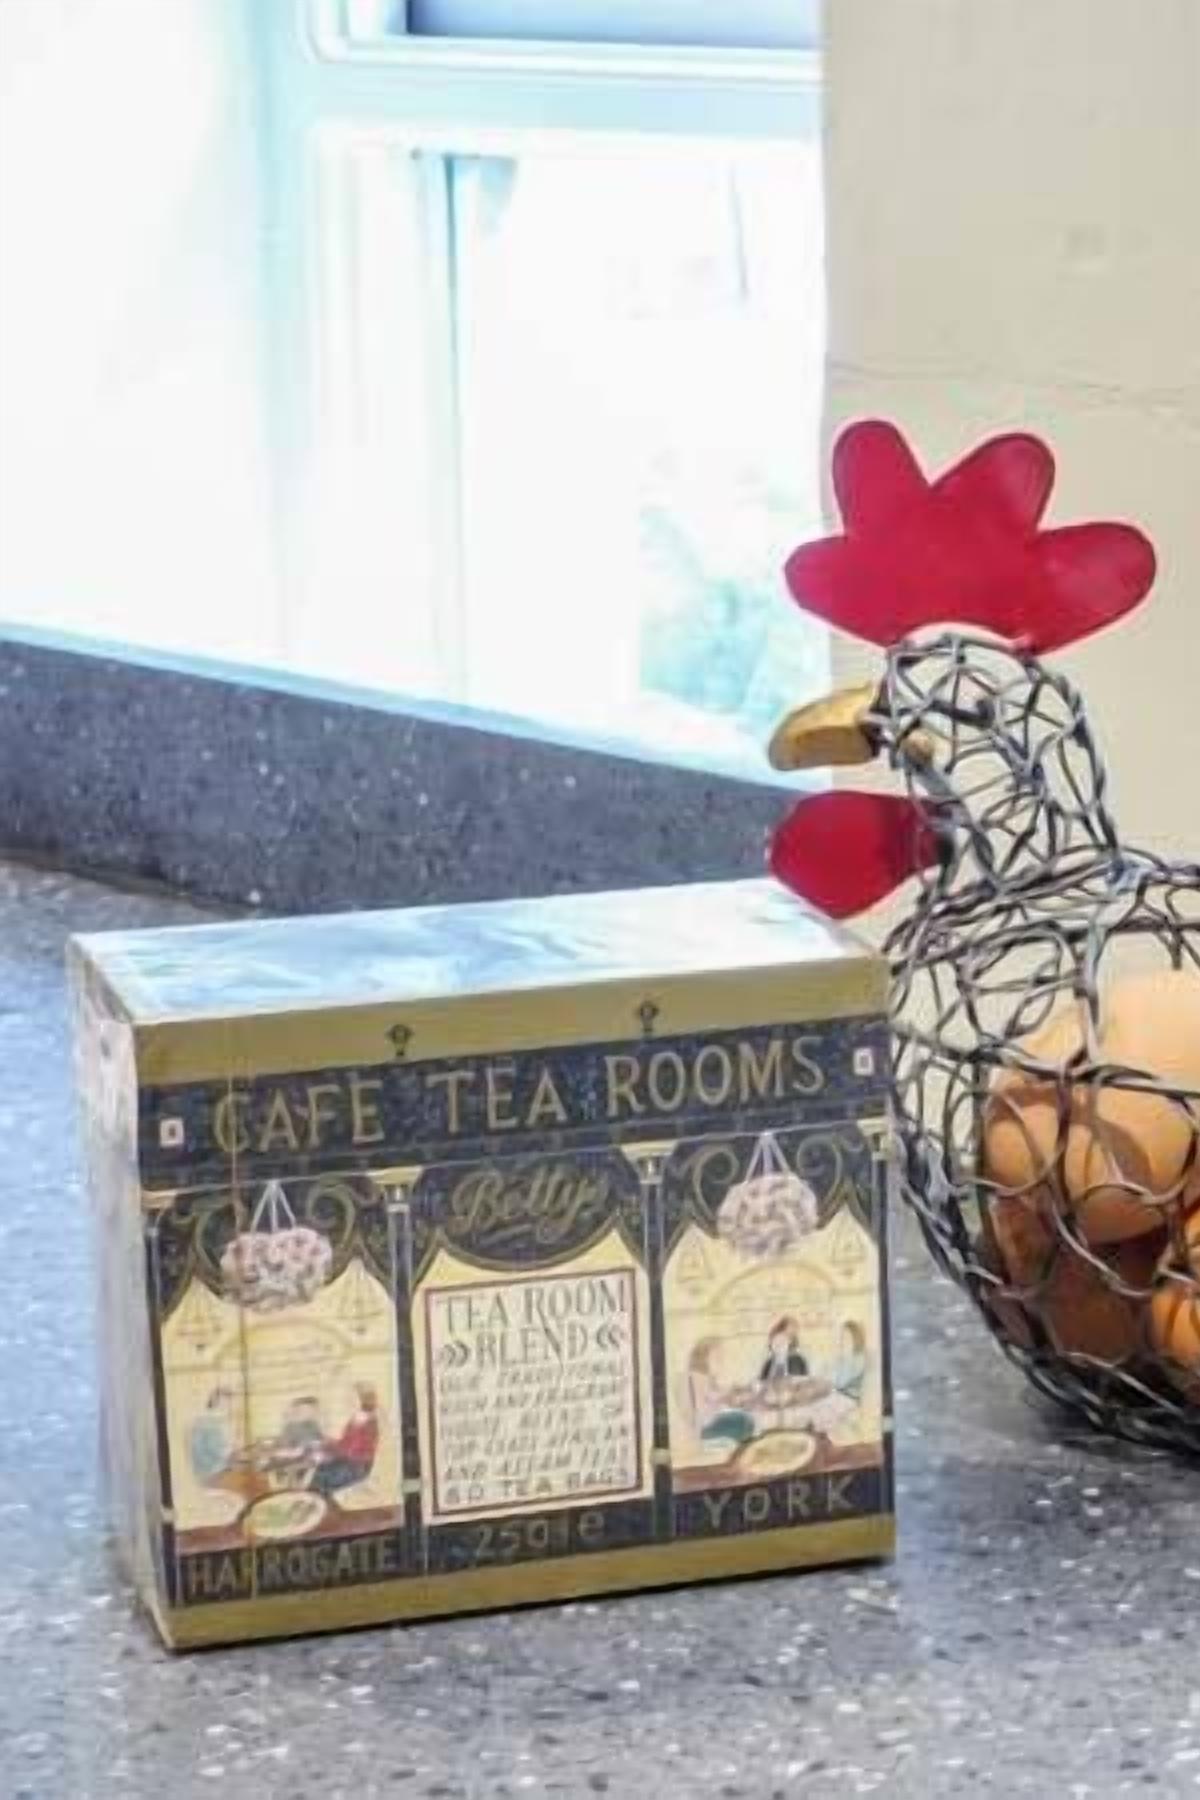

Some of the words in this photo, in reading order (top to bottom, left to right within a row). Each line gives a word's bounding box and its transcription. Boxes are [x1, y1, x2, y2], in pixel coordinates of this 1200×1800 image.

[213, 1079, 385, 1152] CAFE
[425, 1066, 568, 1133] TEA
[604, 1036, 824, 1117] ROOMS
[437, 1291, 509, 1333] TEA
[524, 1279, 625, 1325] ROOM
[476, 1321, 588, 1368] BLEND
[703, 1475, 853, 1529] YORK
[188, 1537, 398, 1595] HARROGATE
